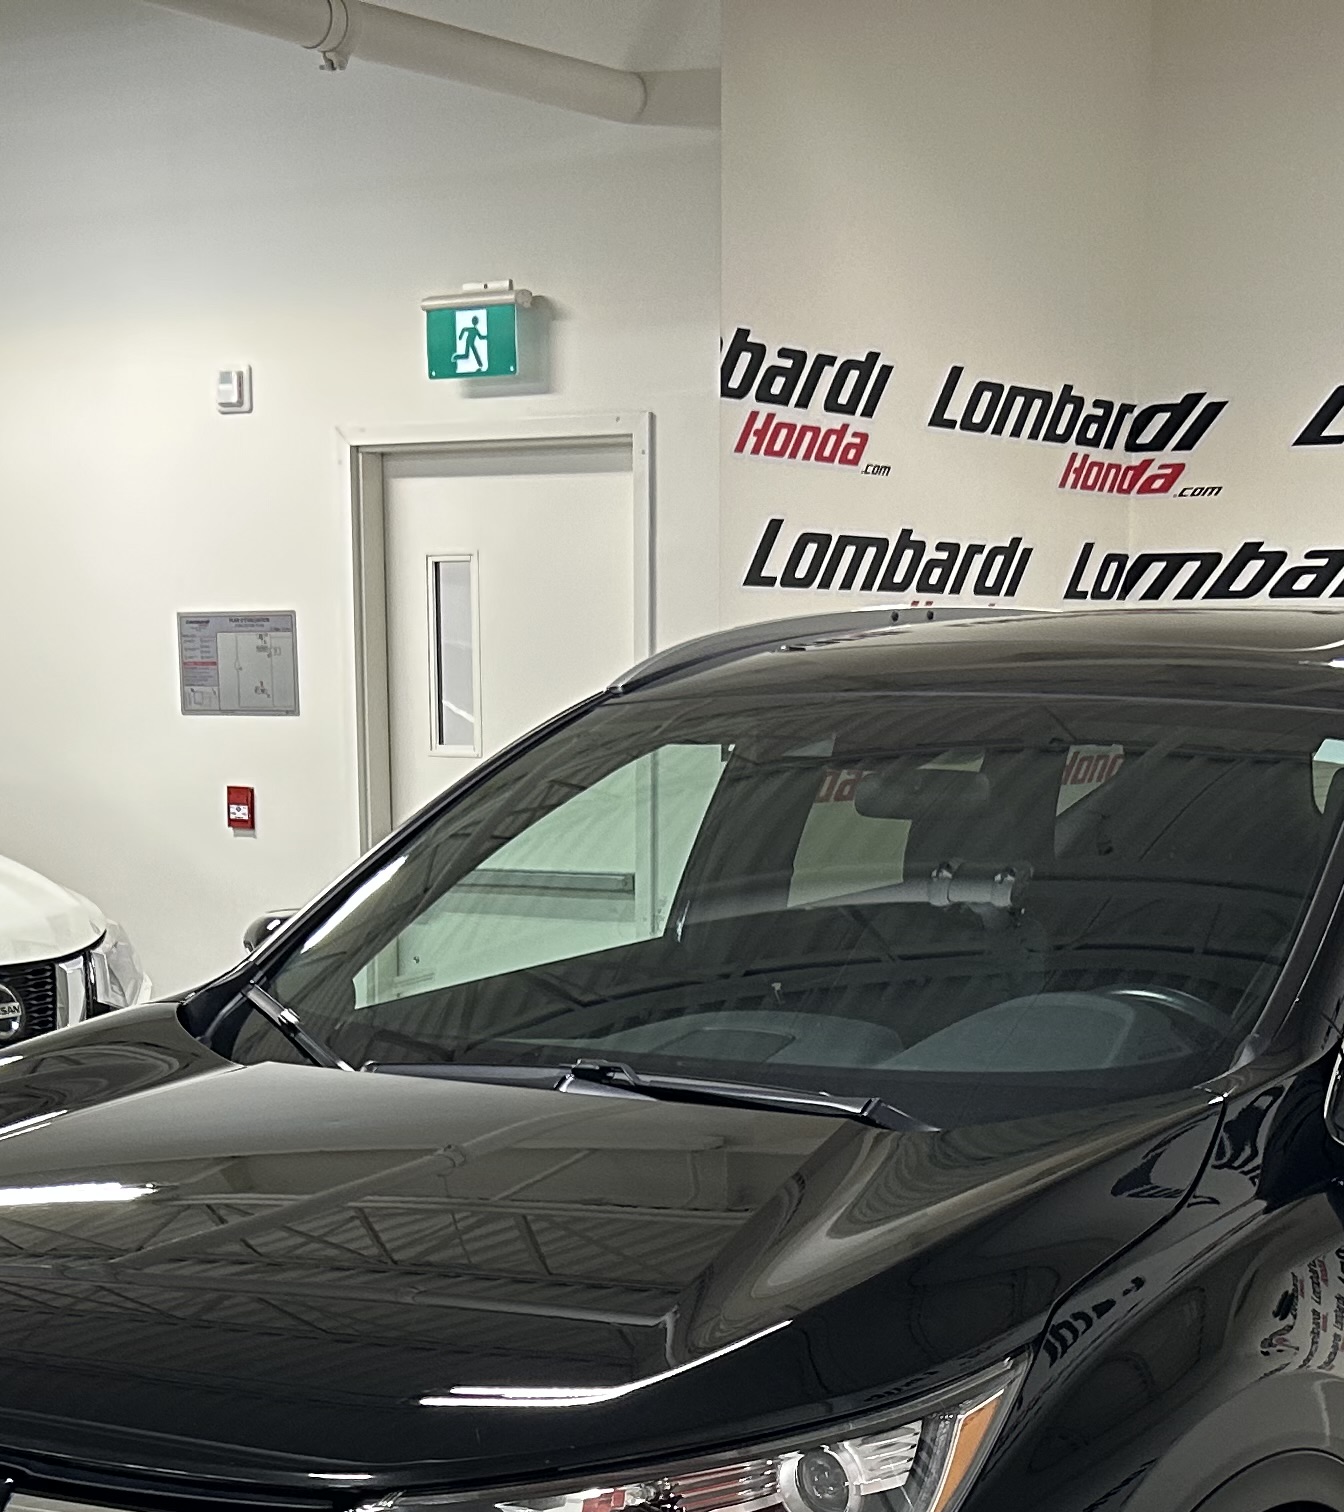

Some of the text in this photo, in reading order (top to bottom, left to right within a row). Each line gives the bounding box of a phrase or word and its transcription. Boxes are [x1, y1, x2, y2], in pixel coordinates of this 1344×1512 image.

[720, 328, 894, 418] bardi
[928, 366, 1229, 453] Lombardi
[734, 411, 869, 467] Honda
[1059, 453, 1185, 496] Honda
[743, 518, 1033, 597] Lombardi
